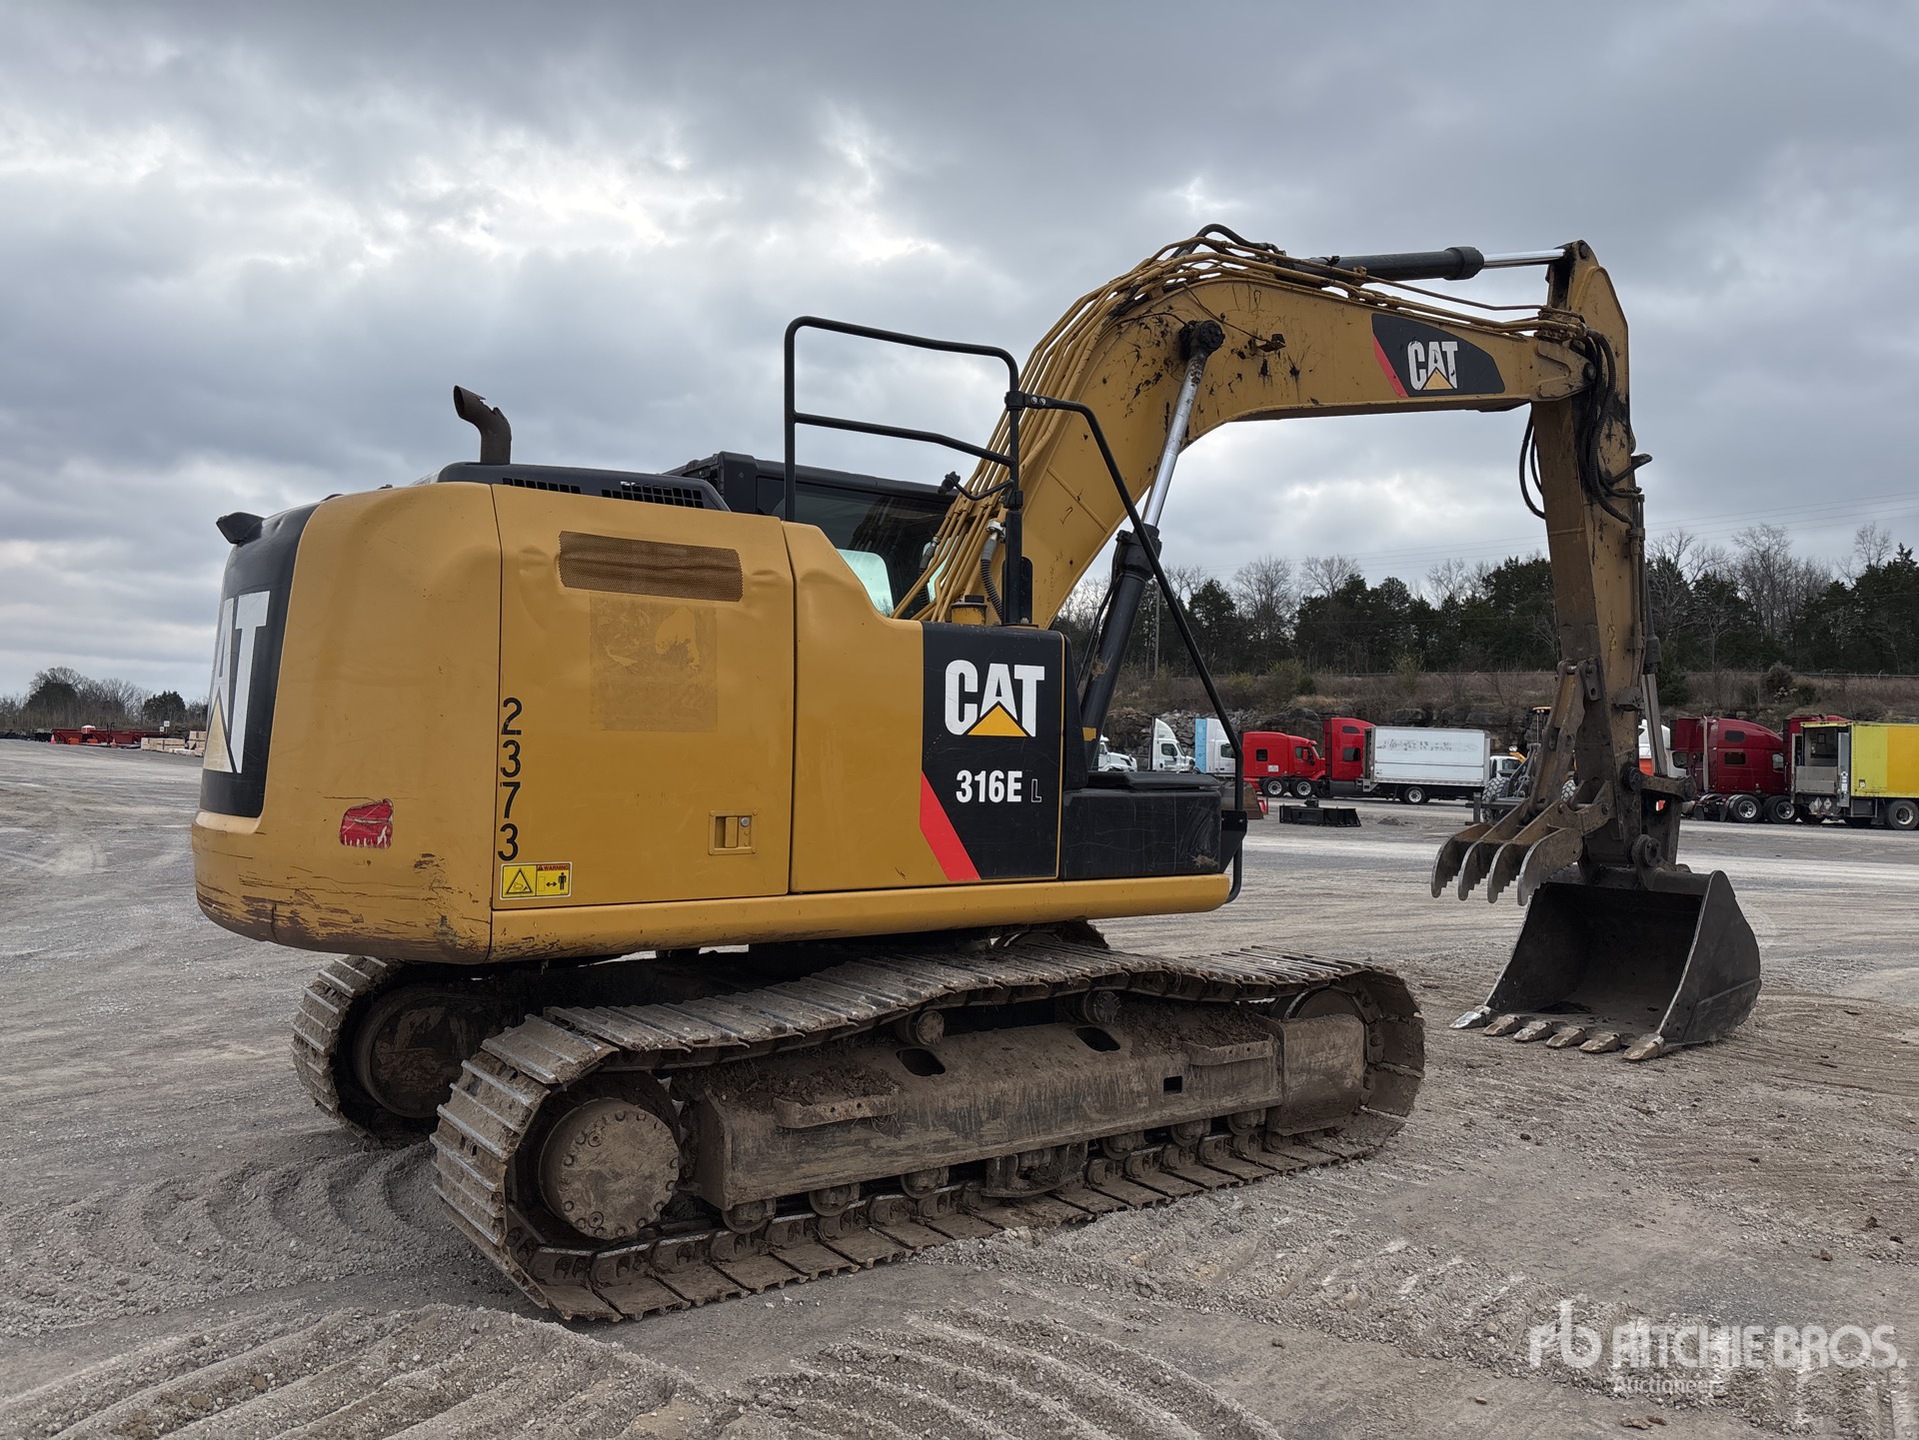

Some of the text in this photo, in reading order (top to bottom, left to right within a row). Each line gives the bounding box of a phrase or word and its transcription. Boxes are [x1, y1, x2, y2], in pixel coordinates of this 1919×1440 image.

[1407, 340, 1458, 391] CAT
[204, 591, 270, 773] AT
[945, 659, 1045, 737] CAT
[497, 697, 523, 862] 2373
[955, 769, 1042, 803] 316E L
